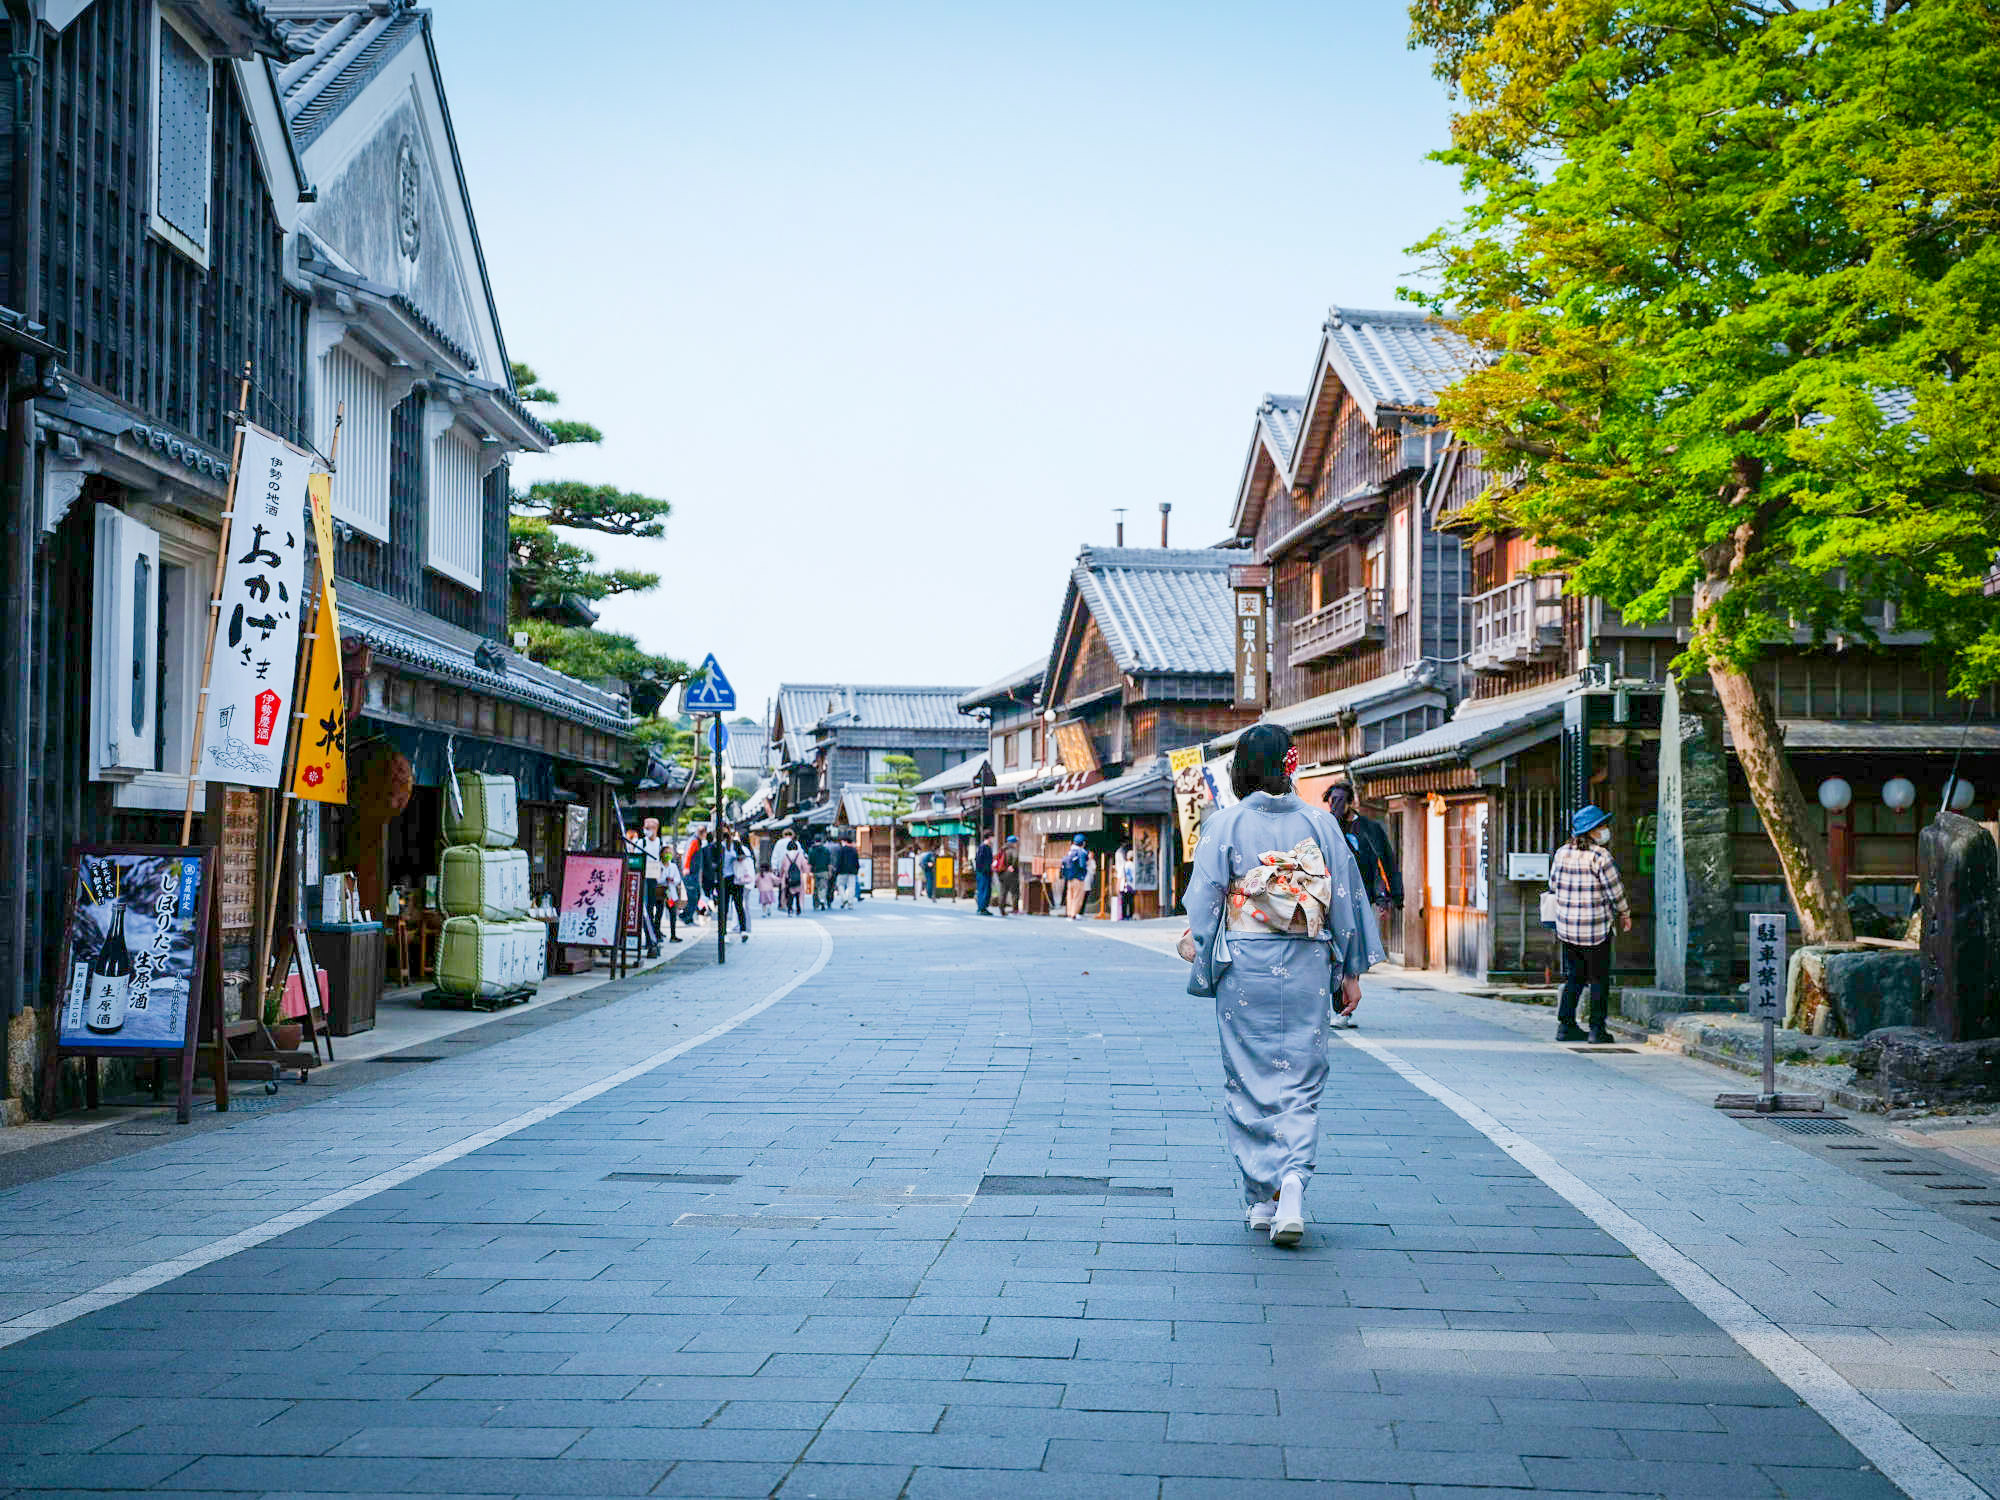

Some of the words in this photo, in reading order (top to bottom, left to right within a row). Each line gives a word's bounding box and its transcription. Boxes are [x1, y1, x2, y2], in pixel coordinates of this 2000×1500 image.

[265, 456, 283, 517] 伊勢の地酒
[228, 523, 295, 680] おかげさま
[152, 873, 178, 971] しぼりたて
[129, 951, 153, 1010] 生原酒
[1757, 923, 1779, 1007] 駐車禁止
[96, 984, 116, 1025] 生原酒
